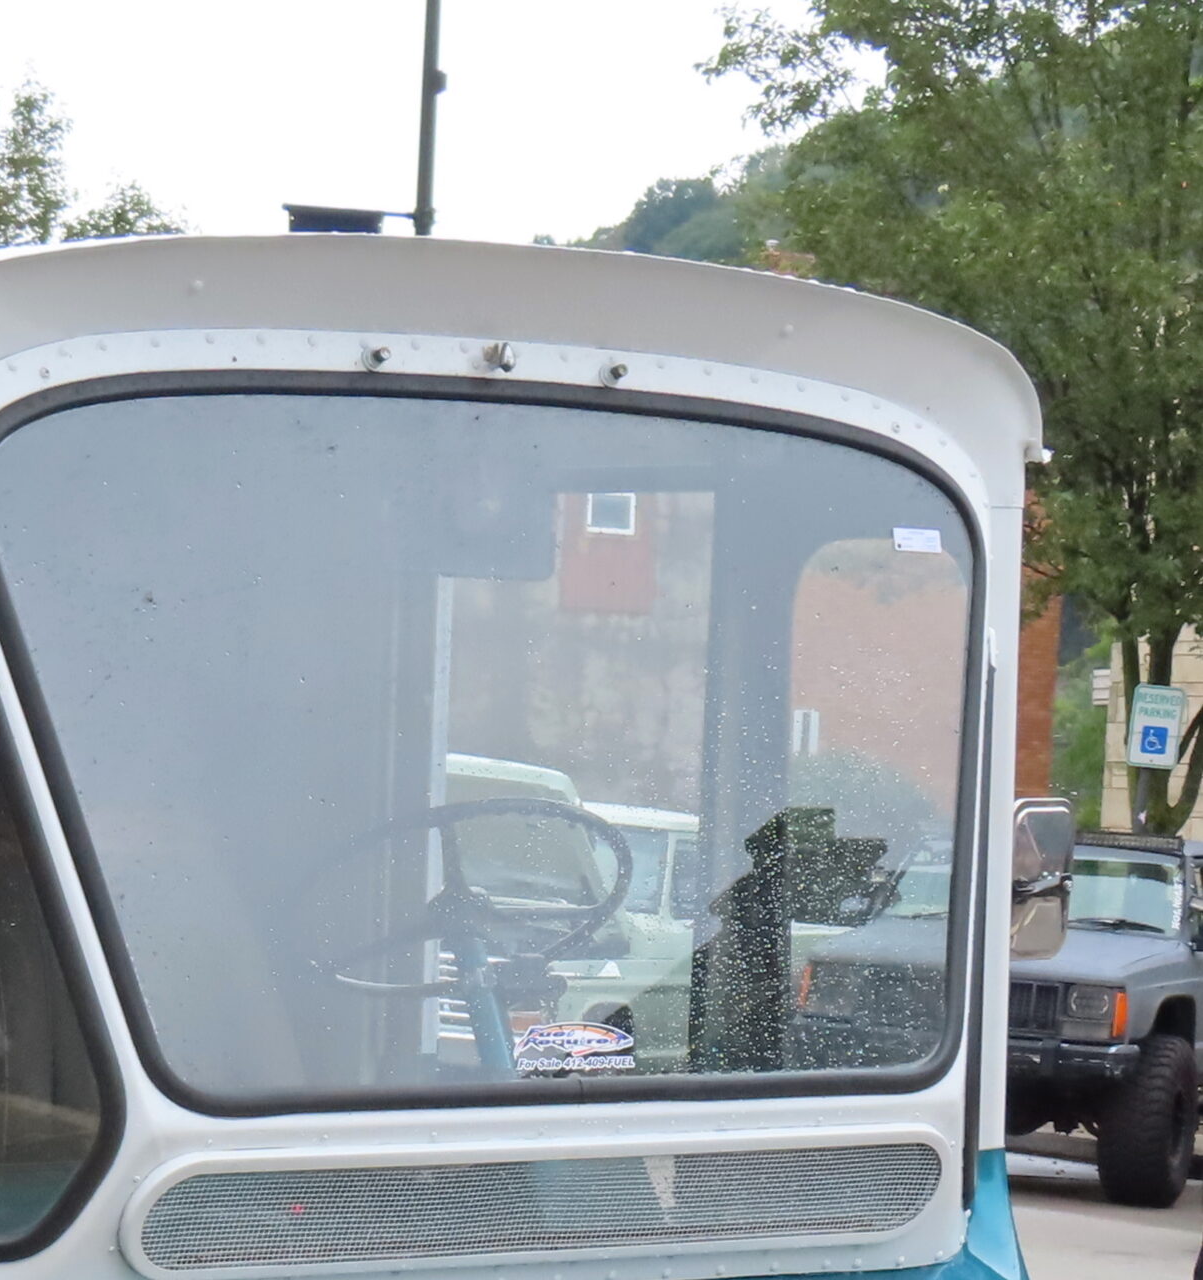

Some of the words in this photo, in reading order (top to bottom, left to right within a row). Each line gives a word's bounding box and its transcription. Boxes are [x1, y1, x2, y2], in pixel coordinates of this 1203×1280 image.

[518, 1058, 536, 1068] For
[539, 1057, 561, 1069] Sale
[564, 1056, 635, 1068] 412-409-FUEL
